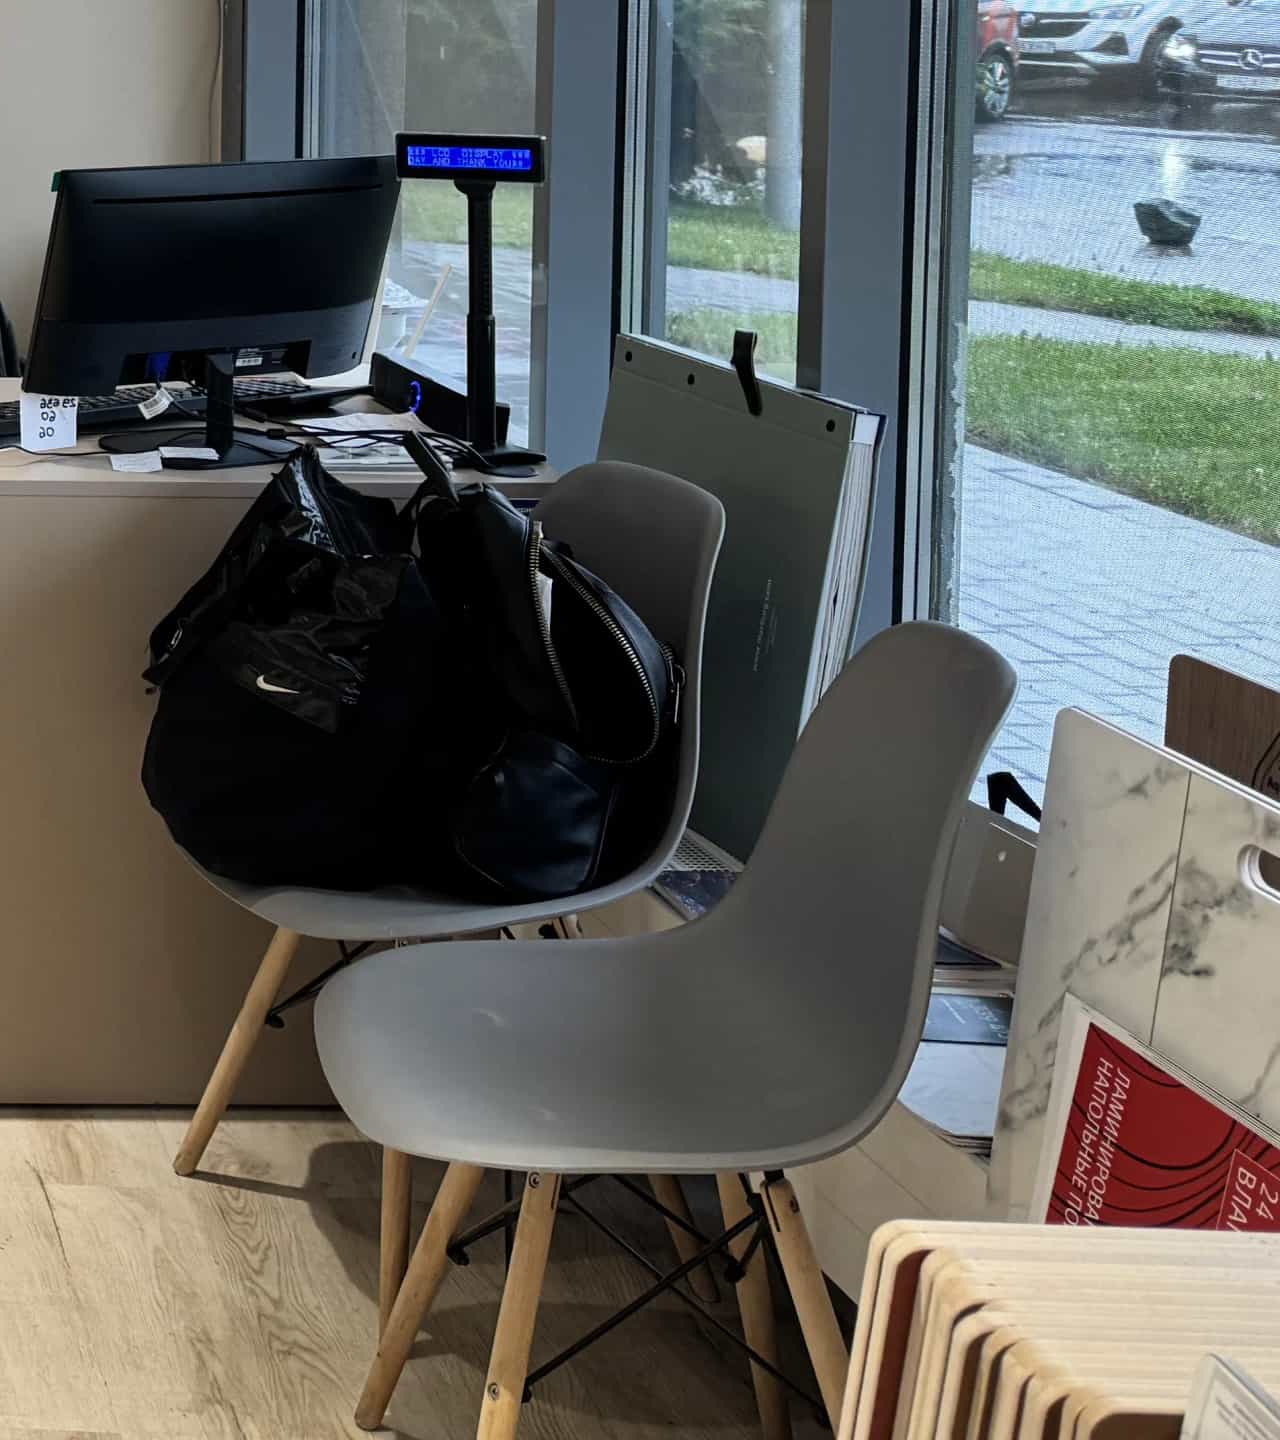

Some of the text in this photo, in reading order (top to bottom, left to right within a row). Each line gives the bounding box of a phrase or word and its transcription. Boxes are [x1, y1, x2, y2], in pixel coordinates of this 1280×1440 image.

[1071, 1057, 1114, 1193] НАПОЛЬНЫЕ
[1084, 1067, 1130, 1226] ЛАМИНИРОВА
[1256, 1183, 1280, 1221] 24
